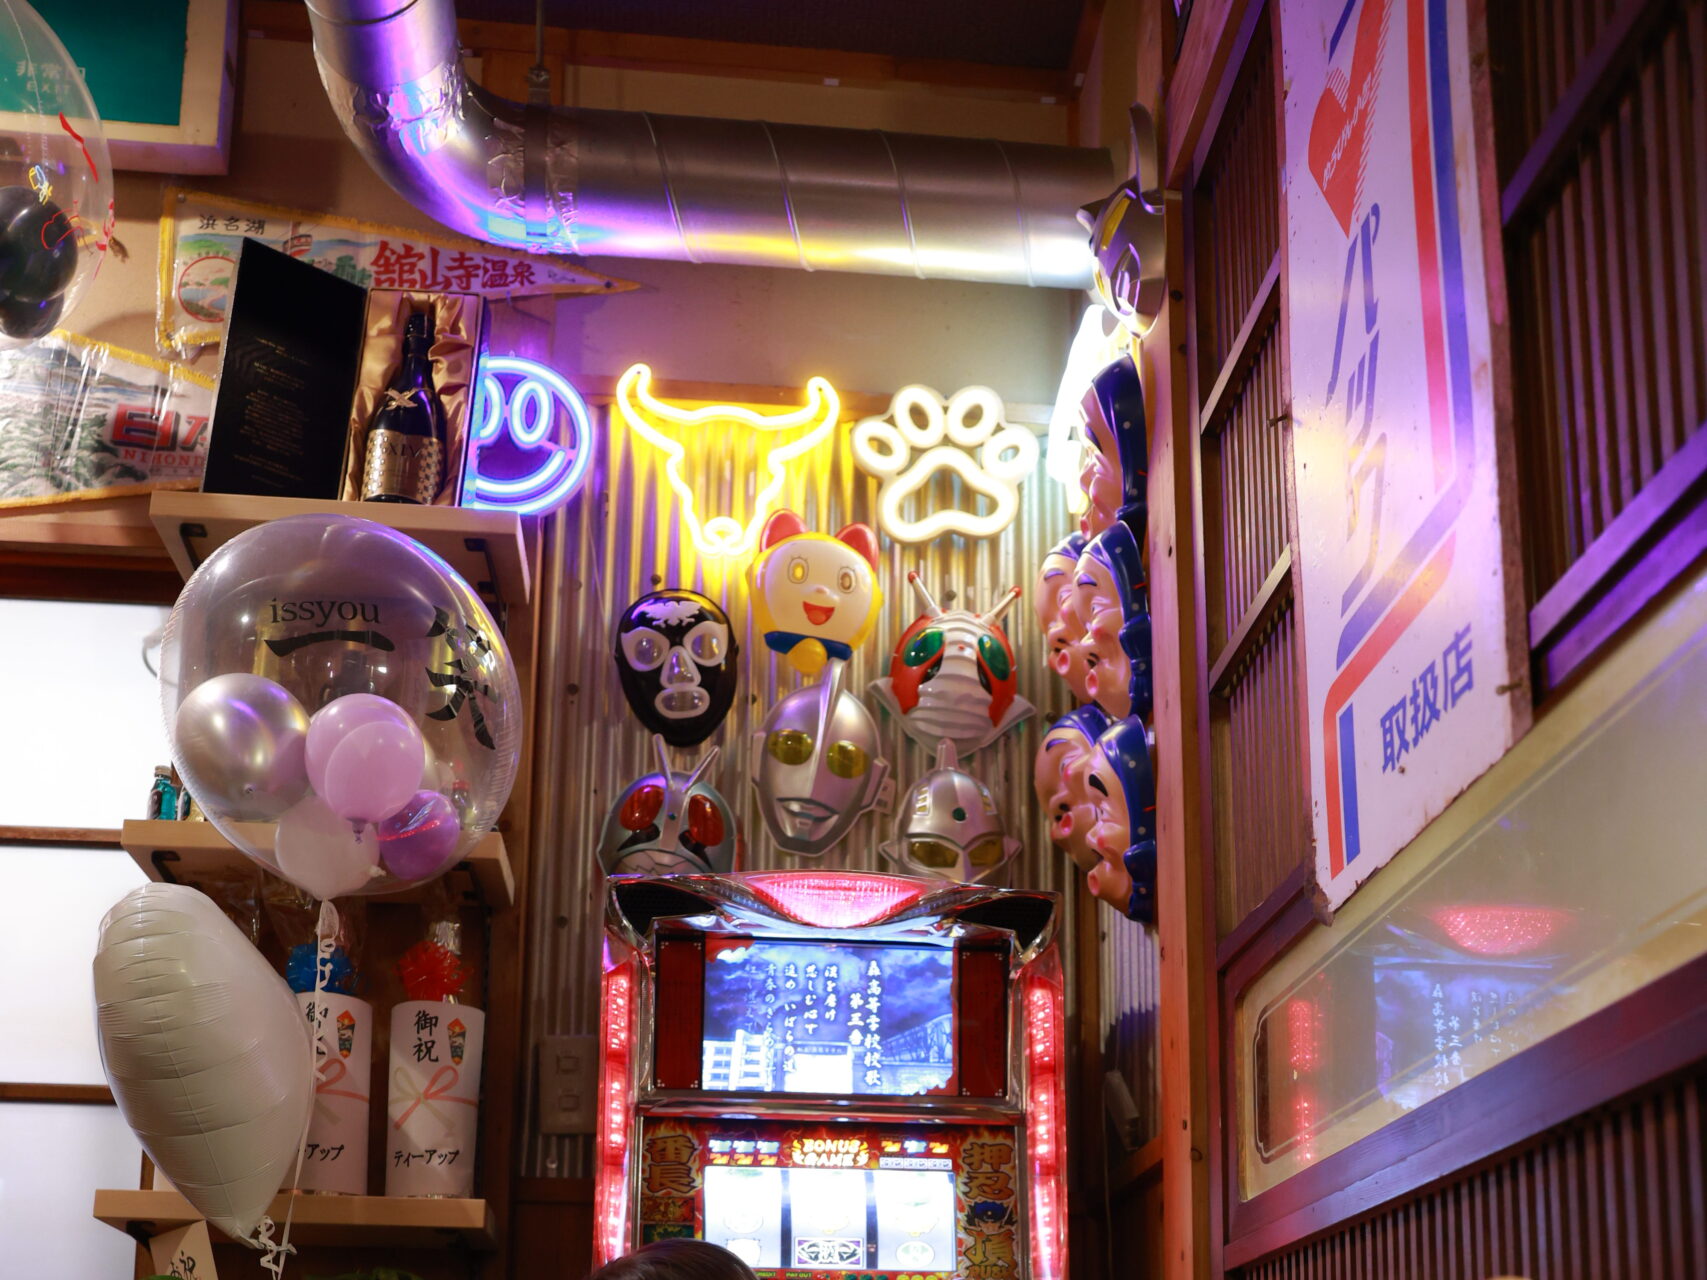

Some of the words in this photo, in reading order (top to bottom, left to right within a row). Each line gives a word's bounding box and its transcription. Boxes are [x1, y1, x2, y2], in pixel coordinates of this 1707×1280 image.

[198, 215, 266, 235] 浜名湖
[270, 597, 381, 628] issyou
[1380, 622, 1474, 774] 取扱店
[413, 1009, 439, 1063] 御祝
[394, 1149, 460, 1168] ティーアップ
[802, 1139, 861, 1153] BONUS
